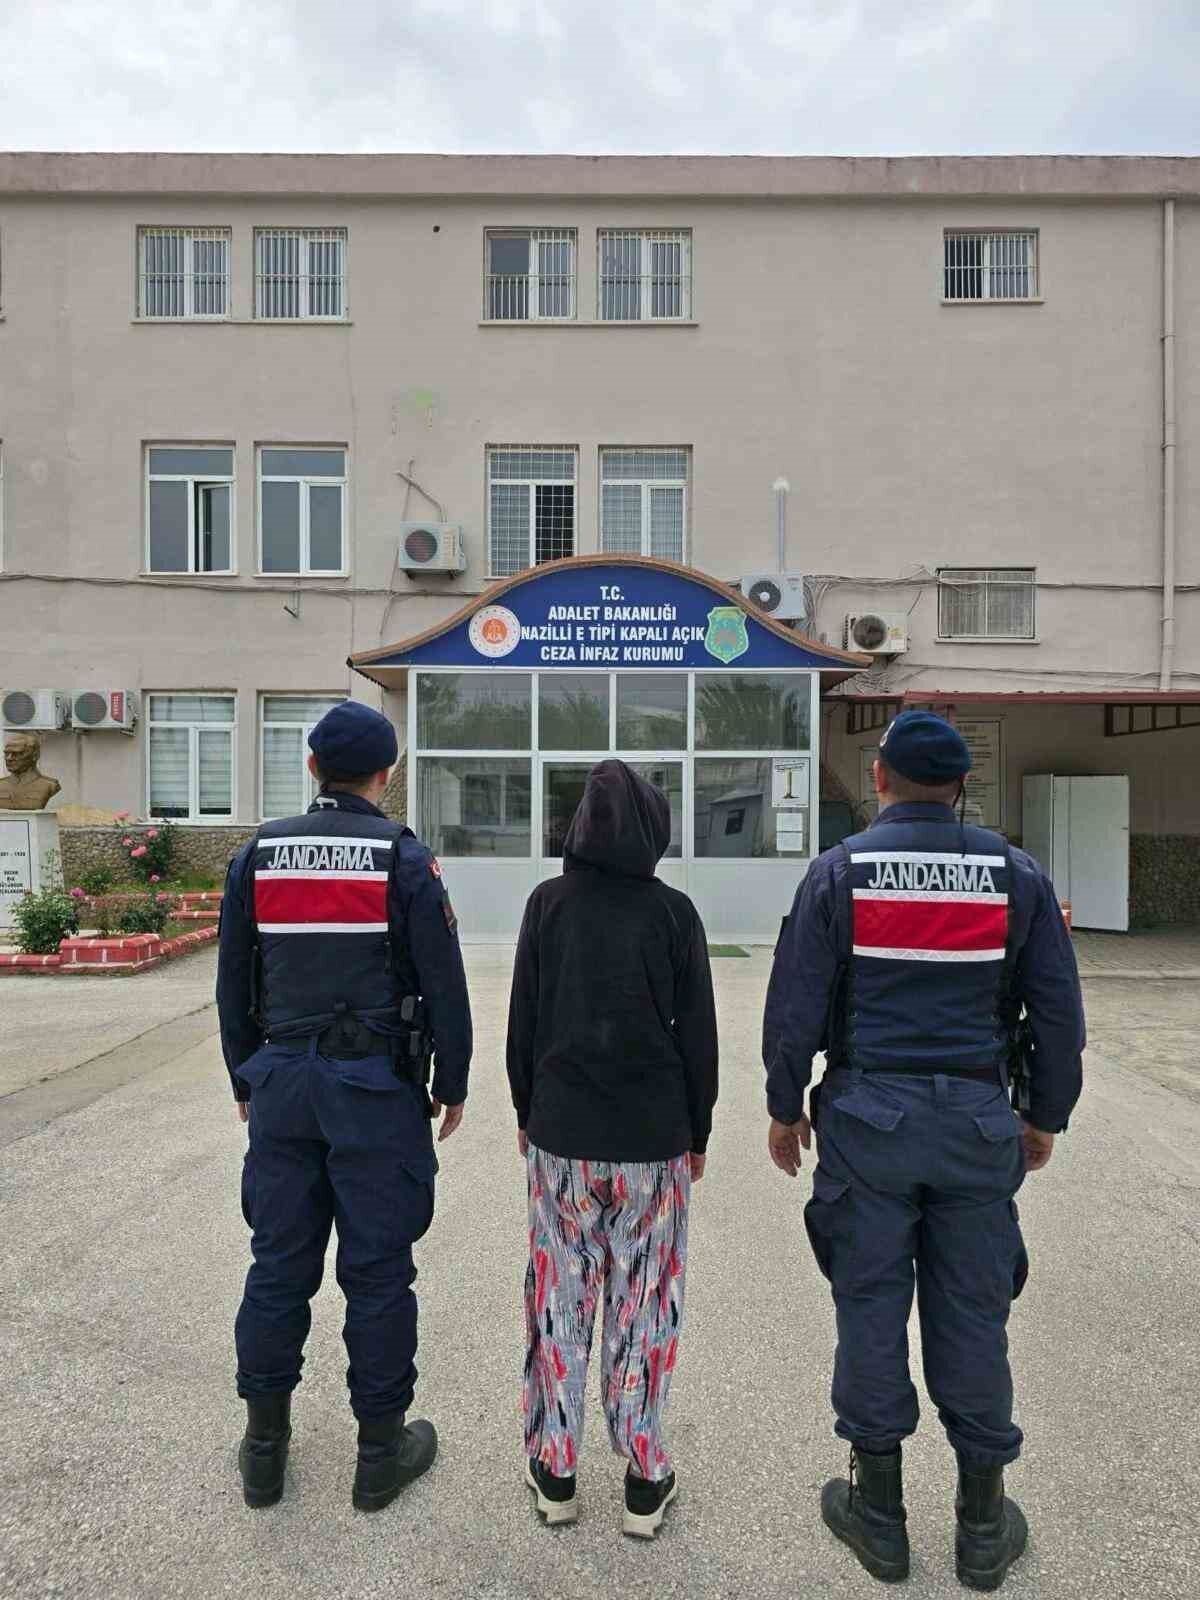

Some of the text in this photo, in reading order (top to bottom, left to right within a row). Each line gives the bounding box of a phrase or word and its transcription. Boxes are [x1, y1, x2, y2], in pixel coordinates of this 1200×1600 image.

[599, 586, 625, 601] T.C.
[548, 603, 677, 621] ADALET BAKANLIĞI
[521, 623, 705, 645] NAZİLLİ E TİPİ KAPALI AÇIK
[540, 643, 684, 661] CEZA İNFAZ KURUMU
[268, 846, 375, 870] JANDARMA
[868, 862, 997, 892] JANDARMA
